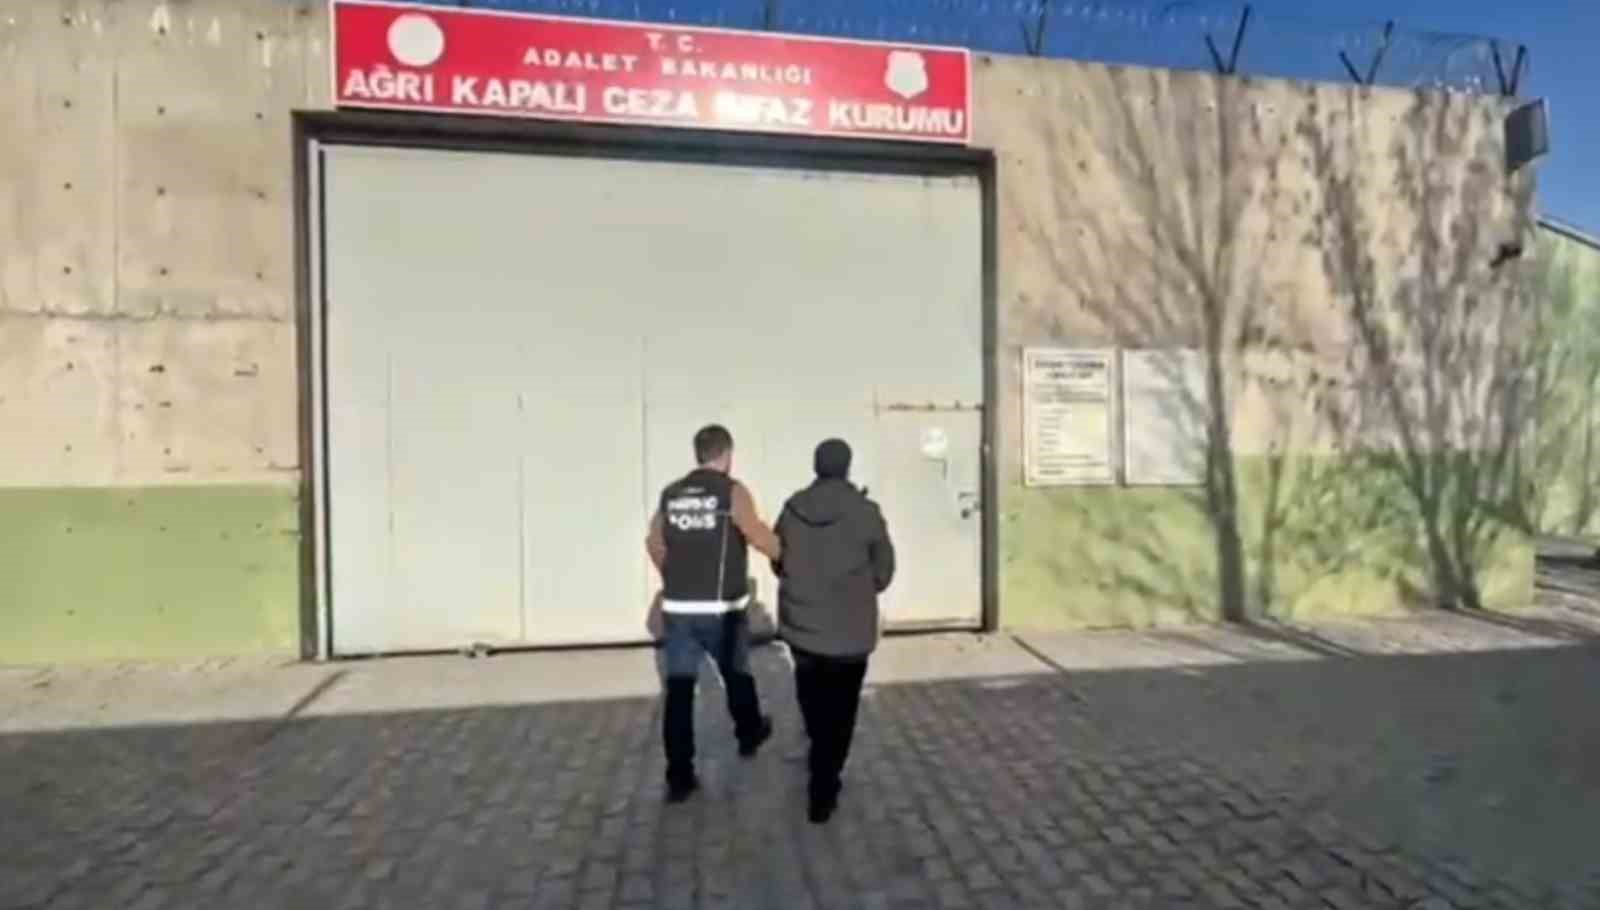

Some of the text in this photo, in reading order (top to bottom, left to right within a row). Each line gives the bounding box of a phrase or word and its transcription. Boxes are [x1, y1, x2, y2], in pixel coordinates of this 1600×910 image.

[523, 47, 638, 72] ADALET
[343, 64, 435, 102] AĞRI
[452, 76, 586, 113] KAPALI
[602, 85, 698, 116] CEZA
[827, 101, 965, 135] KURUMU
